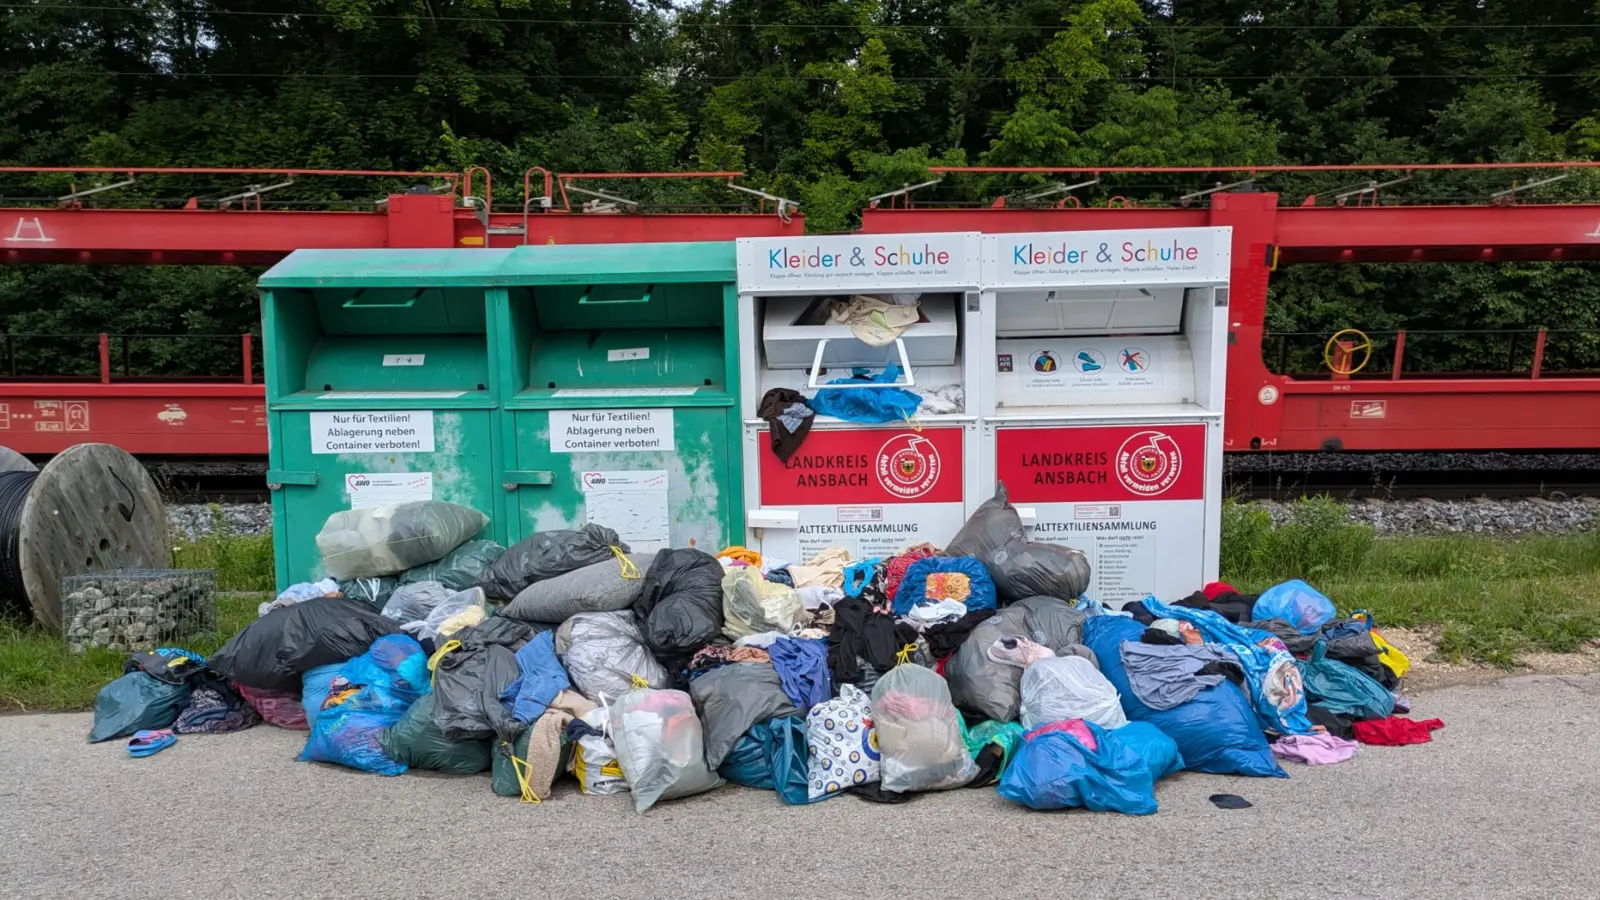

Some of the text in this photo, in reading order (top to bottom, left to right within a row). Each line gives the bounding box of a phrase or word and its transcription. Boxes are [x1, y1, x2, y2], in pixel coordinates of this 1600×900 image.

[768, 243, 950, 268] Kleider & Schuhe
[1014, 238, 1198, 265] Kleider & Schuhe
[333, 414, 410, 424] Nur für Textilien!
[572, 412, 650, 422] Nur für Textilien!
[328, 427, 415, 438] Ablagerung neben
[566, 425, 655, 437] Ablagerung neben
[326, 440, 420, 450] Container verboten!
[564, 438, 660, 448] Container verboten!
[784, 454, 868, 469] LANDKREIS
[1022, 452, 1108, 467] LANDKREIS
[880, 454, 936, 494] Abfall vermeiden verwerten
[1034, 470, 1107, 484] ANSBACH
[1120, 450, 1177, 492] Abfall vermeiden verwerten
[797, 473, 868, 487] ANSBACH
[799, 524, 918, 534] ALTTEXTILIENSAMMLUNG
[1034, 521, 1157, 531] ALTTEXTILIENSAMMLUNG
